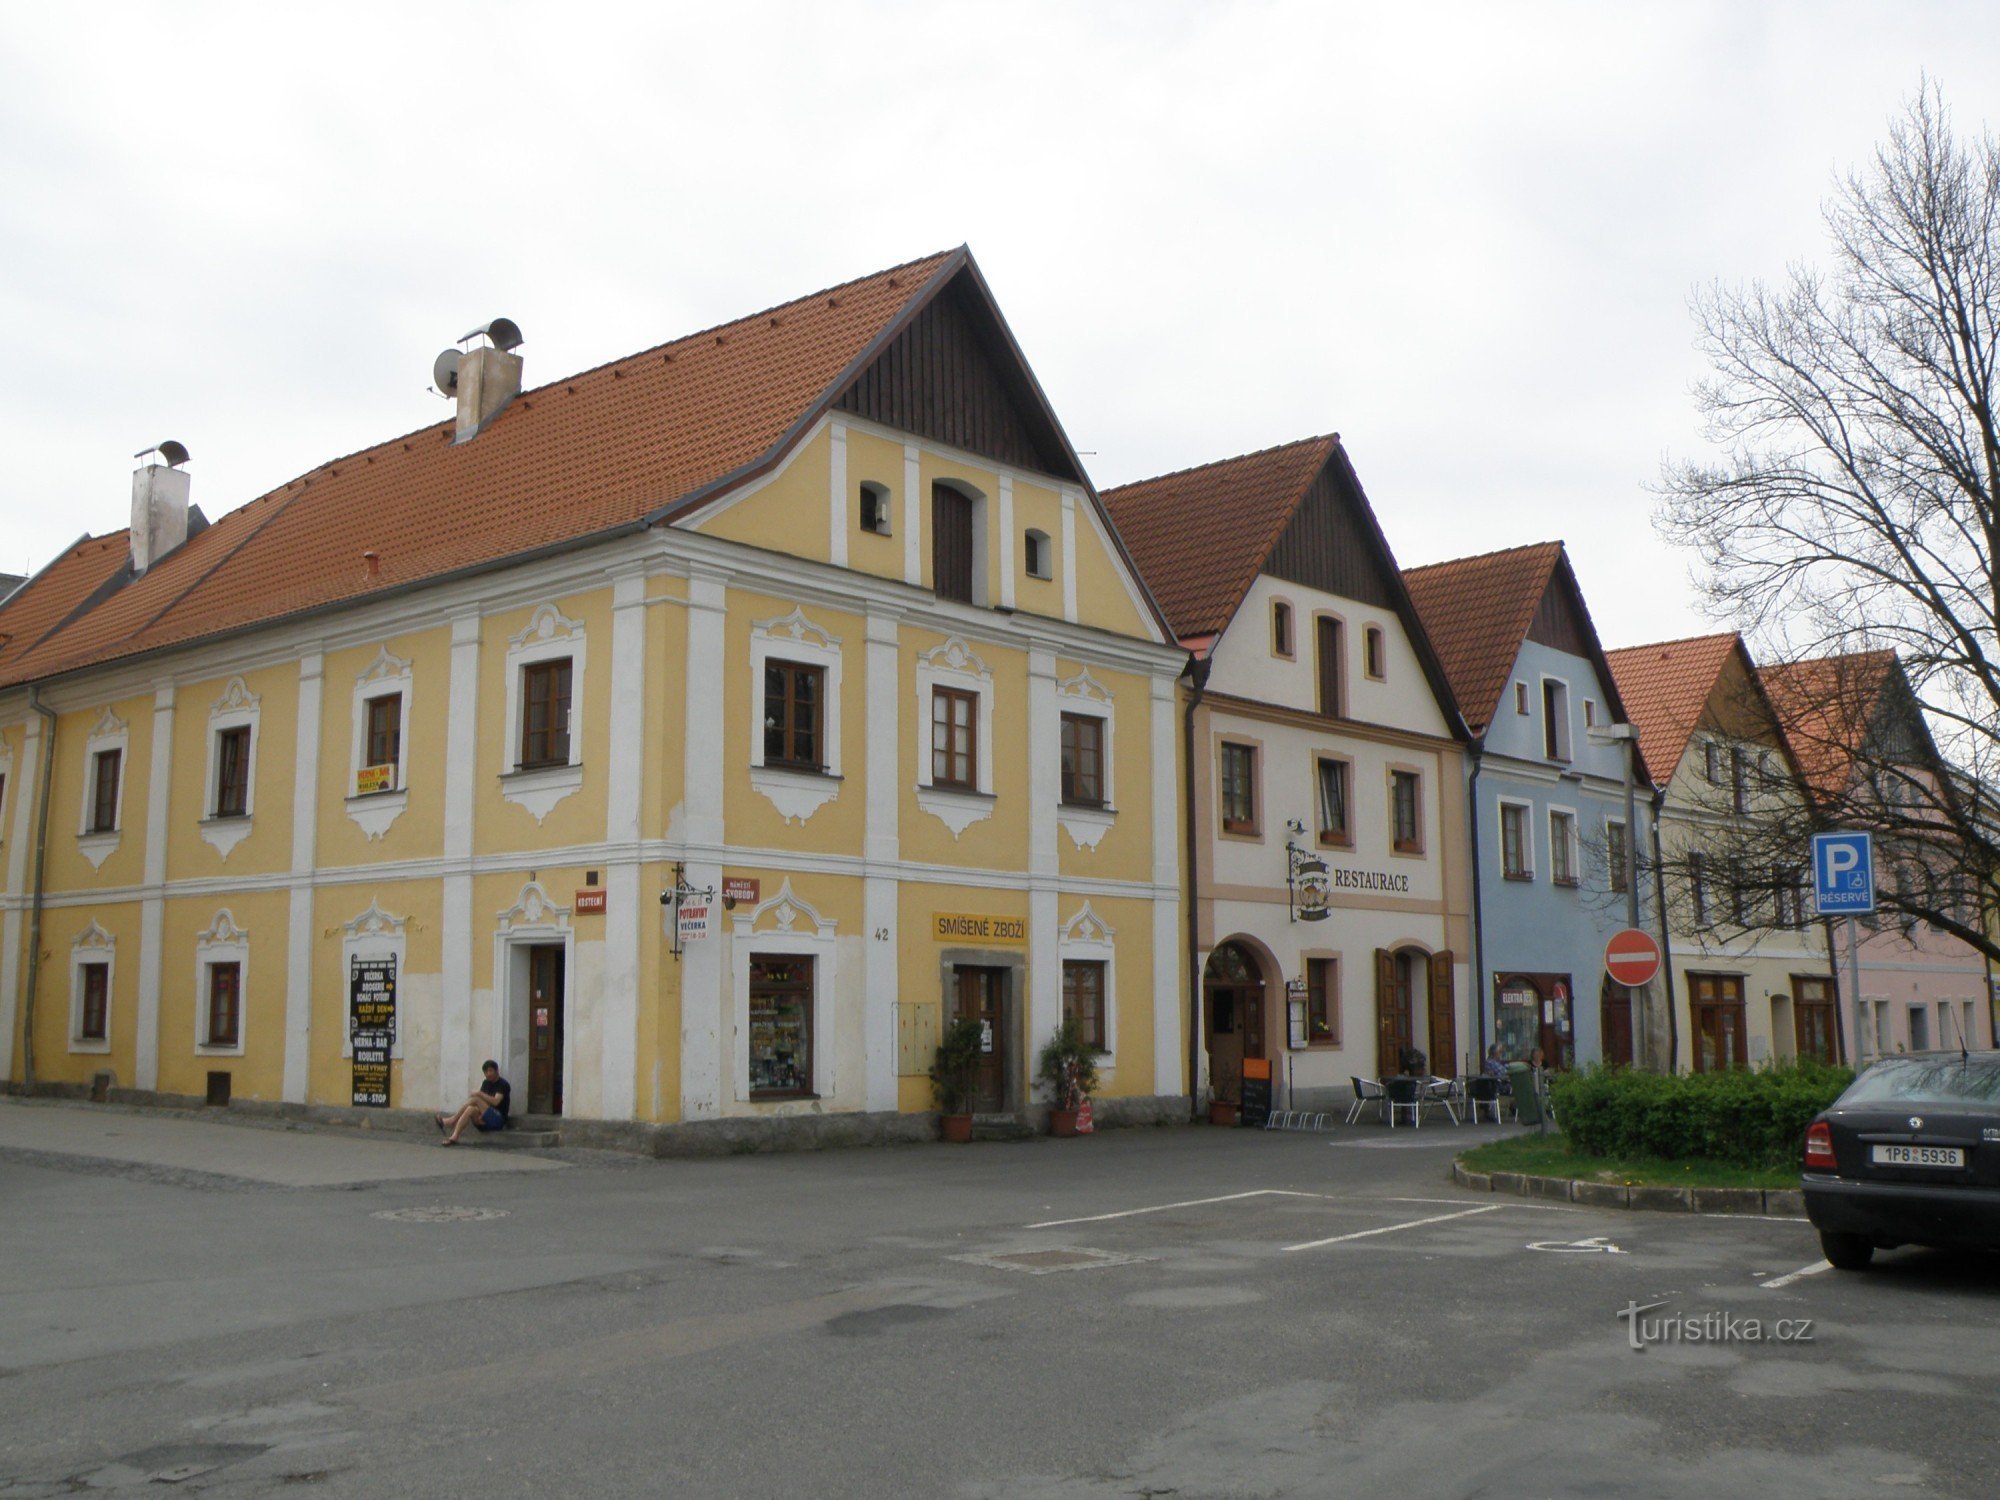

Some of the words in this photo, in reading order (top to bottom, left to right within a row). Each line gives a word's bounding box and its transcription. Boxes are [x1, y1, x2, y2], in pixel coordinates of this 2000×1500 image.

[1826, 844, 1858, 888] P
[1335, 869, 1409, 892] RESTAURACE
[679, 907, 708, 920] POTRAVINY
[680, 920, 706, 931] VEČERKA
[938, 916, 990, 936] SMÍŠENÉ
[993, 919, 1025, 939] ZBOŽÍ
[875, 927, 889, 941] 42
[363, 970, 384, 981] VEČERKA
[376, 1037, 388, 1048] BAR
[357, 1051, 384, 1062] ROULETTE
[354, 1092, 368, 1103] NON
[371, 1093, 387, 1104] STOP
[1983, 1128, 2000, 1137] OCTA
[1885, 1147, 1910, 1162] 1P8
[1921, 1148, 1957, 1164] 5936
